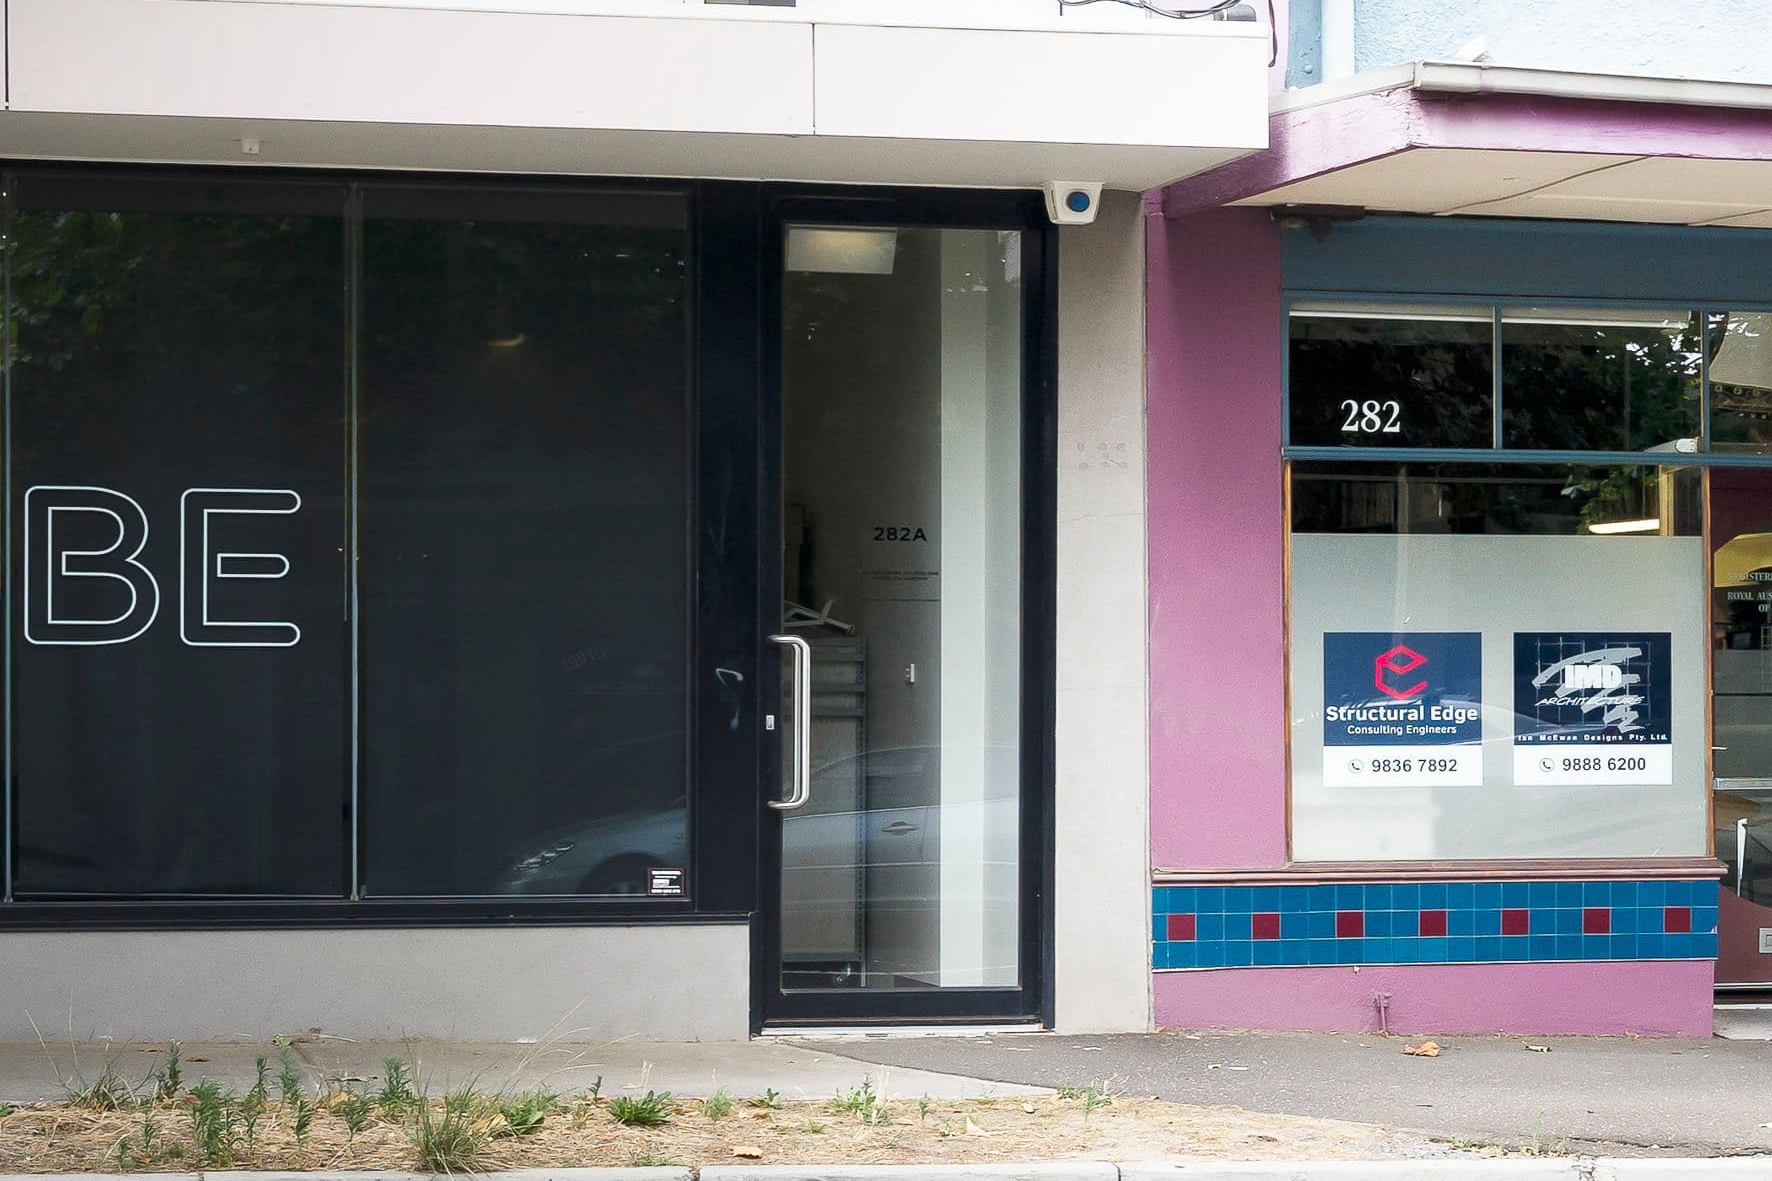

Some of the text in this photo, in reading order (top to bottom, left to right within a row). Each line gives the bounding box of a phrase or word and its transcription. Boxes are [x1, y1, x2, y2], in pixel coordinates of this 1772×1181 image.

[1340, 399, 1401, 433] 282
[873, 527, 928, 542] 282A
[24, 485, 302, 647] BE
[1727, 591, 1754, 601] ROYAL
[1758, 604, 1769, 612] OF
[1534, 695, 1645, 707] ARCHITECTURE
[1326, 705, 1478, 724] Structural Edge
[1347, 724, 1457, 735] Consulting Engineers
[1371, 759, 1457, 772] 9836 7892
[1562, 757, 1646, 771] 9888 6200
